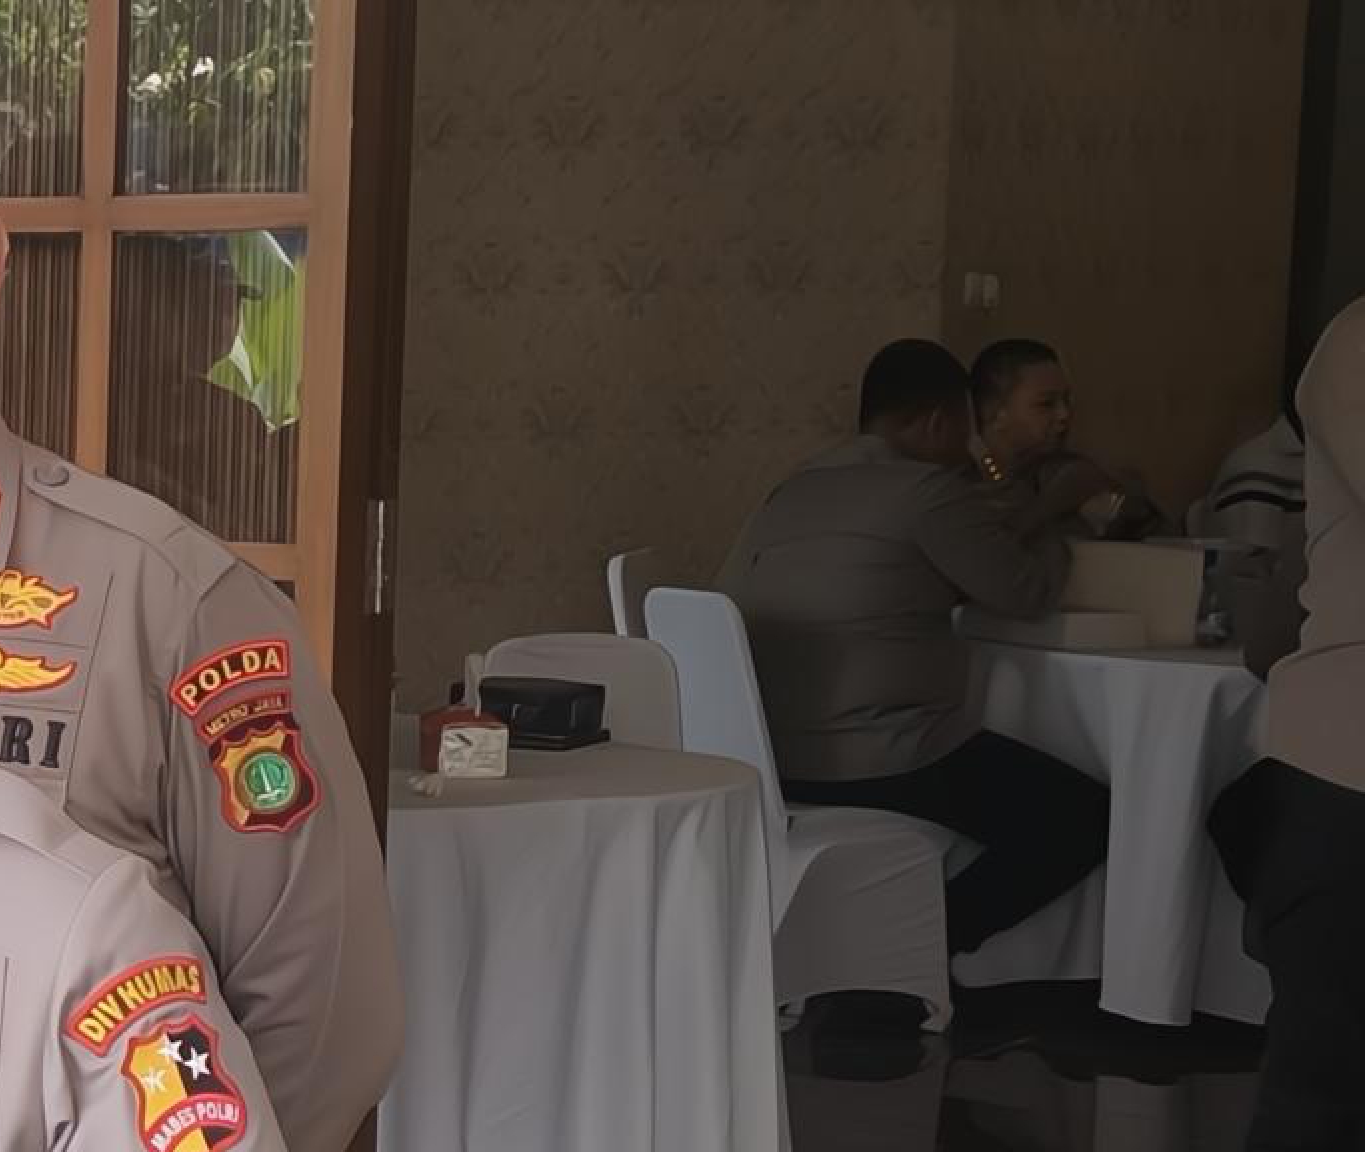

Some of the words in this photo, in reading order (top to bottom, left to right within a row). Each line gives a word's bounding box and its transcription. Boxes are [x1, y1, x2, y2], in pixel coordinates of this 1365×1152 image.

[180, 647, 281, 708] POLDA
[77, 993, 125, 1043] DIV
[116, 965, 201, 1012] HUMAS
[150, 1106, 197, 1152] MABES
[194, 1102, 240, 1123] POLRI
